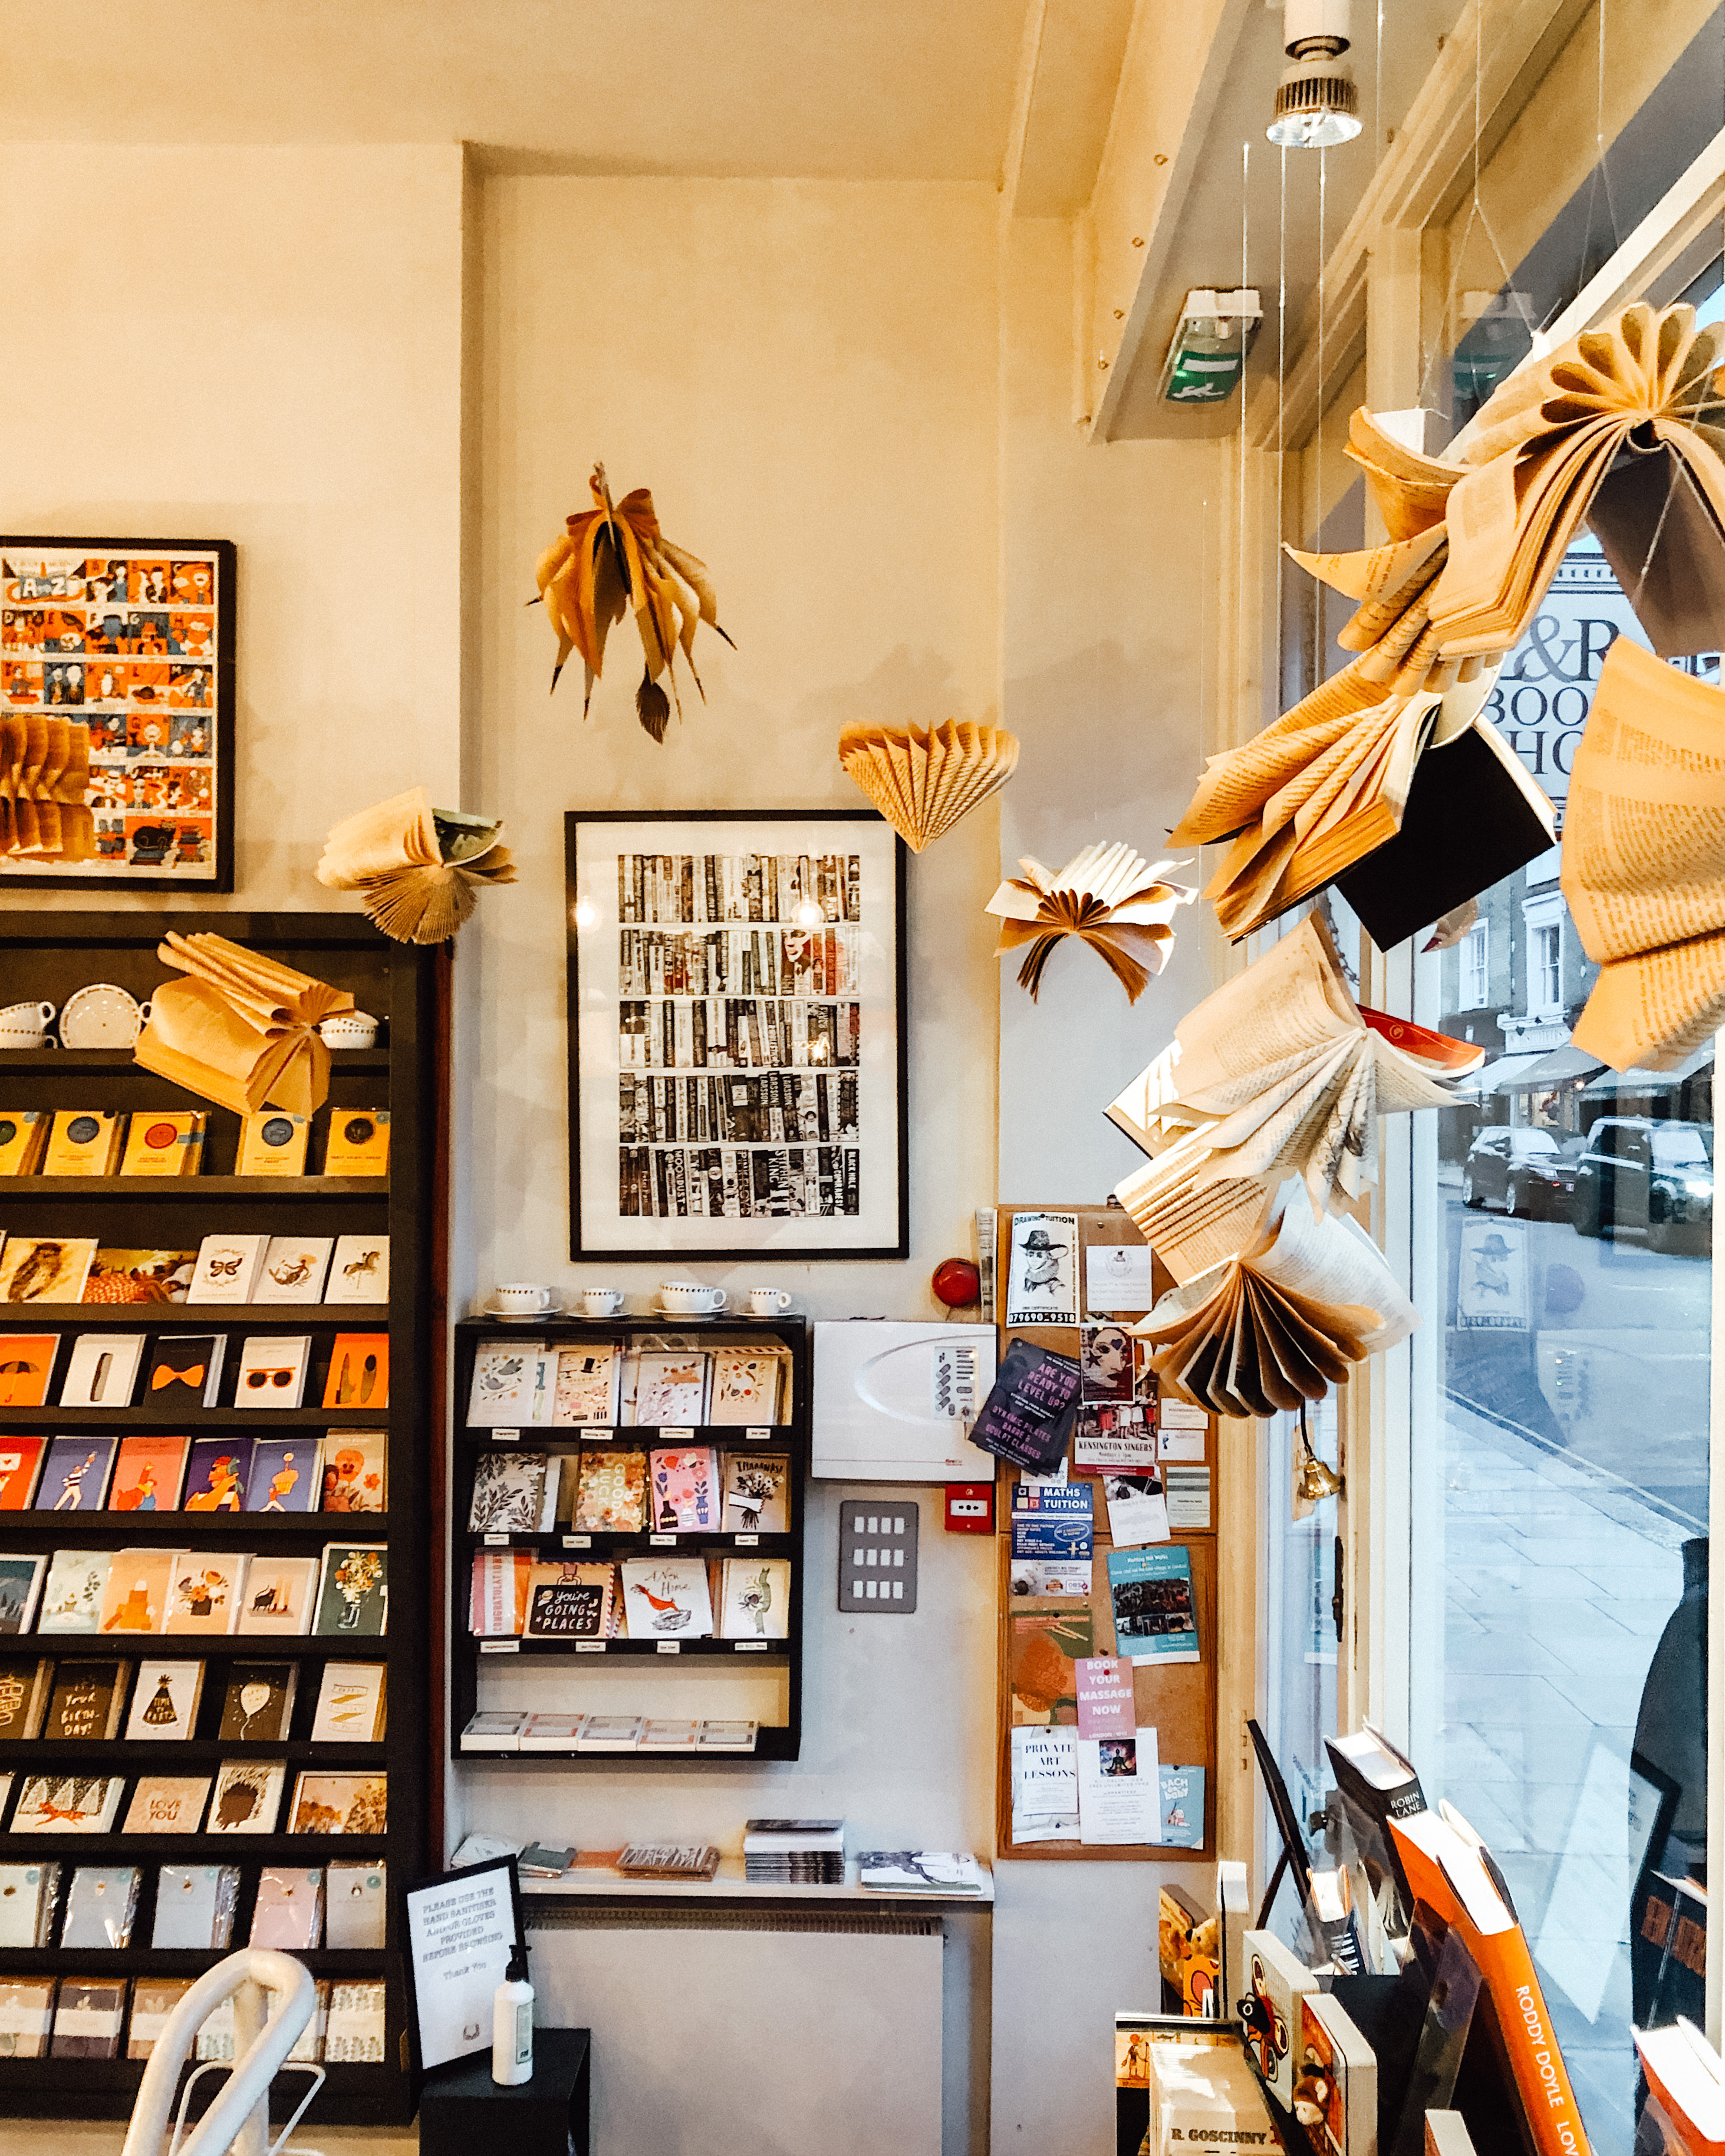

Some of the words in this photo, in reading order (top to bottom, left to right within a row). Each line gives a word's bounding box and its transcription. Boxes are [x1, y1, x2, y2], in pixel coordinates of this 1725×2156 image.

[1500, 615, 1620, 683] &R
[1487, 687, 1596, 726] BOO
[759, 1076, 768, 1104] LARSSON
[769, 1072, 779, 1104] LARSSON
[782, 1076, 792, 1105] LARSSON
[768, 1157, 780, 1183] KING
[848, 1151, 856, 1171] BLACK
[674, 1150, 686, 1204] MOONDUST
[1045, 1215, 1075, 1225] TUITION
[1009, 1313, 1075, 1322] 0796909518
[1038, 1362, 1058, 1378] ARE
[1059, 1372, 1078, 1390] YOU
[1018, 1380, 1044, 1401] LEVEL
[1027, 1371, 1059, 1393] READY
[1059, 1387, 1072, 1400] TO
[992, 1404, 1023, 1427] DYNAMIC
[1023, 1422, 1051, 1443] PILATES
[1002, 1422, 1025, 1440] BARRE
[985, 1423, 1012, 1443] SCULPT
[1011, 1437, 1042, 1460] CLASSES
[1078, 1440, 1121, 1451] KENSINGTON
[1124, 1442, 1153, 1452] SINGERS
[1044, 1488, 1081, 1497] MATHS
[1044, 1499, 1088, 1509] TUITION
[545, 1604, 585, 1616] GOING
[542, 1617, 592, 1630] PLACES
[1087, 1660, 1118, 1670] BOOK
[1089, 1674, 1120, 1685] YOUR
[1079, 1688, 1132, 1701] MASSAGE
[1092, 1704, 1121, 1716] NOW
[1025, 1743, 1075, 1754] PRIVATE
[1040, 1756, 1061, 1766] ART
[1024, 1769, 1076, 1780] LESSONS
[1160, 1777, 1189, 1790] BACH
[1390, 1790, 1420, 1809] ROBIN
[149, 1810, 178, 1821] YOU
[1395, 1801, 1421, 1818] LANE
[423, 1897, 457, 1914] PLEASE
[458, 1892, 476, 1904] USE
[476, 1887, 494, 1899] THE
[423, 1912, 449, 1926] HAND
[450, 1898, 497, 1917] SANITISER
[462, 1910, 495, 1927] GLOVES
[440, 1925, 484, 1945] PROVIDED
[422, 1945, 457, 1963] BEFORE
[458, 1931, 503, 1952] BROWSING
[443, 1966, 470, 1980] Thank
[472, 1961, 487, 1972] You
[1515, 1984, 1547, 2047] RODDY
[1535, 2050, 1565, 2109] DOYLE
[1171, 2127, 1185, 2141] R.
[1188, 2128, 1268, 2145] GOSCINNY
